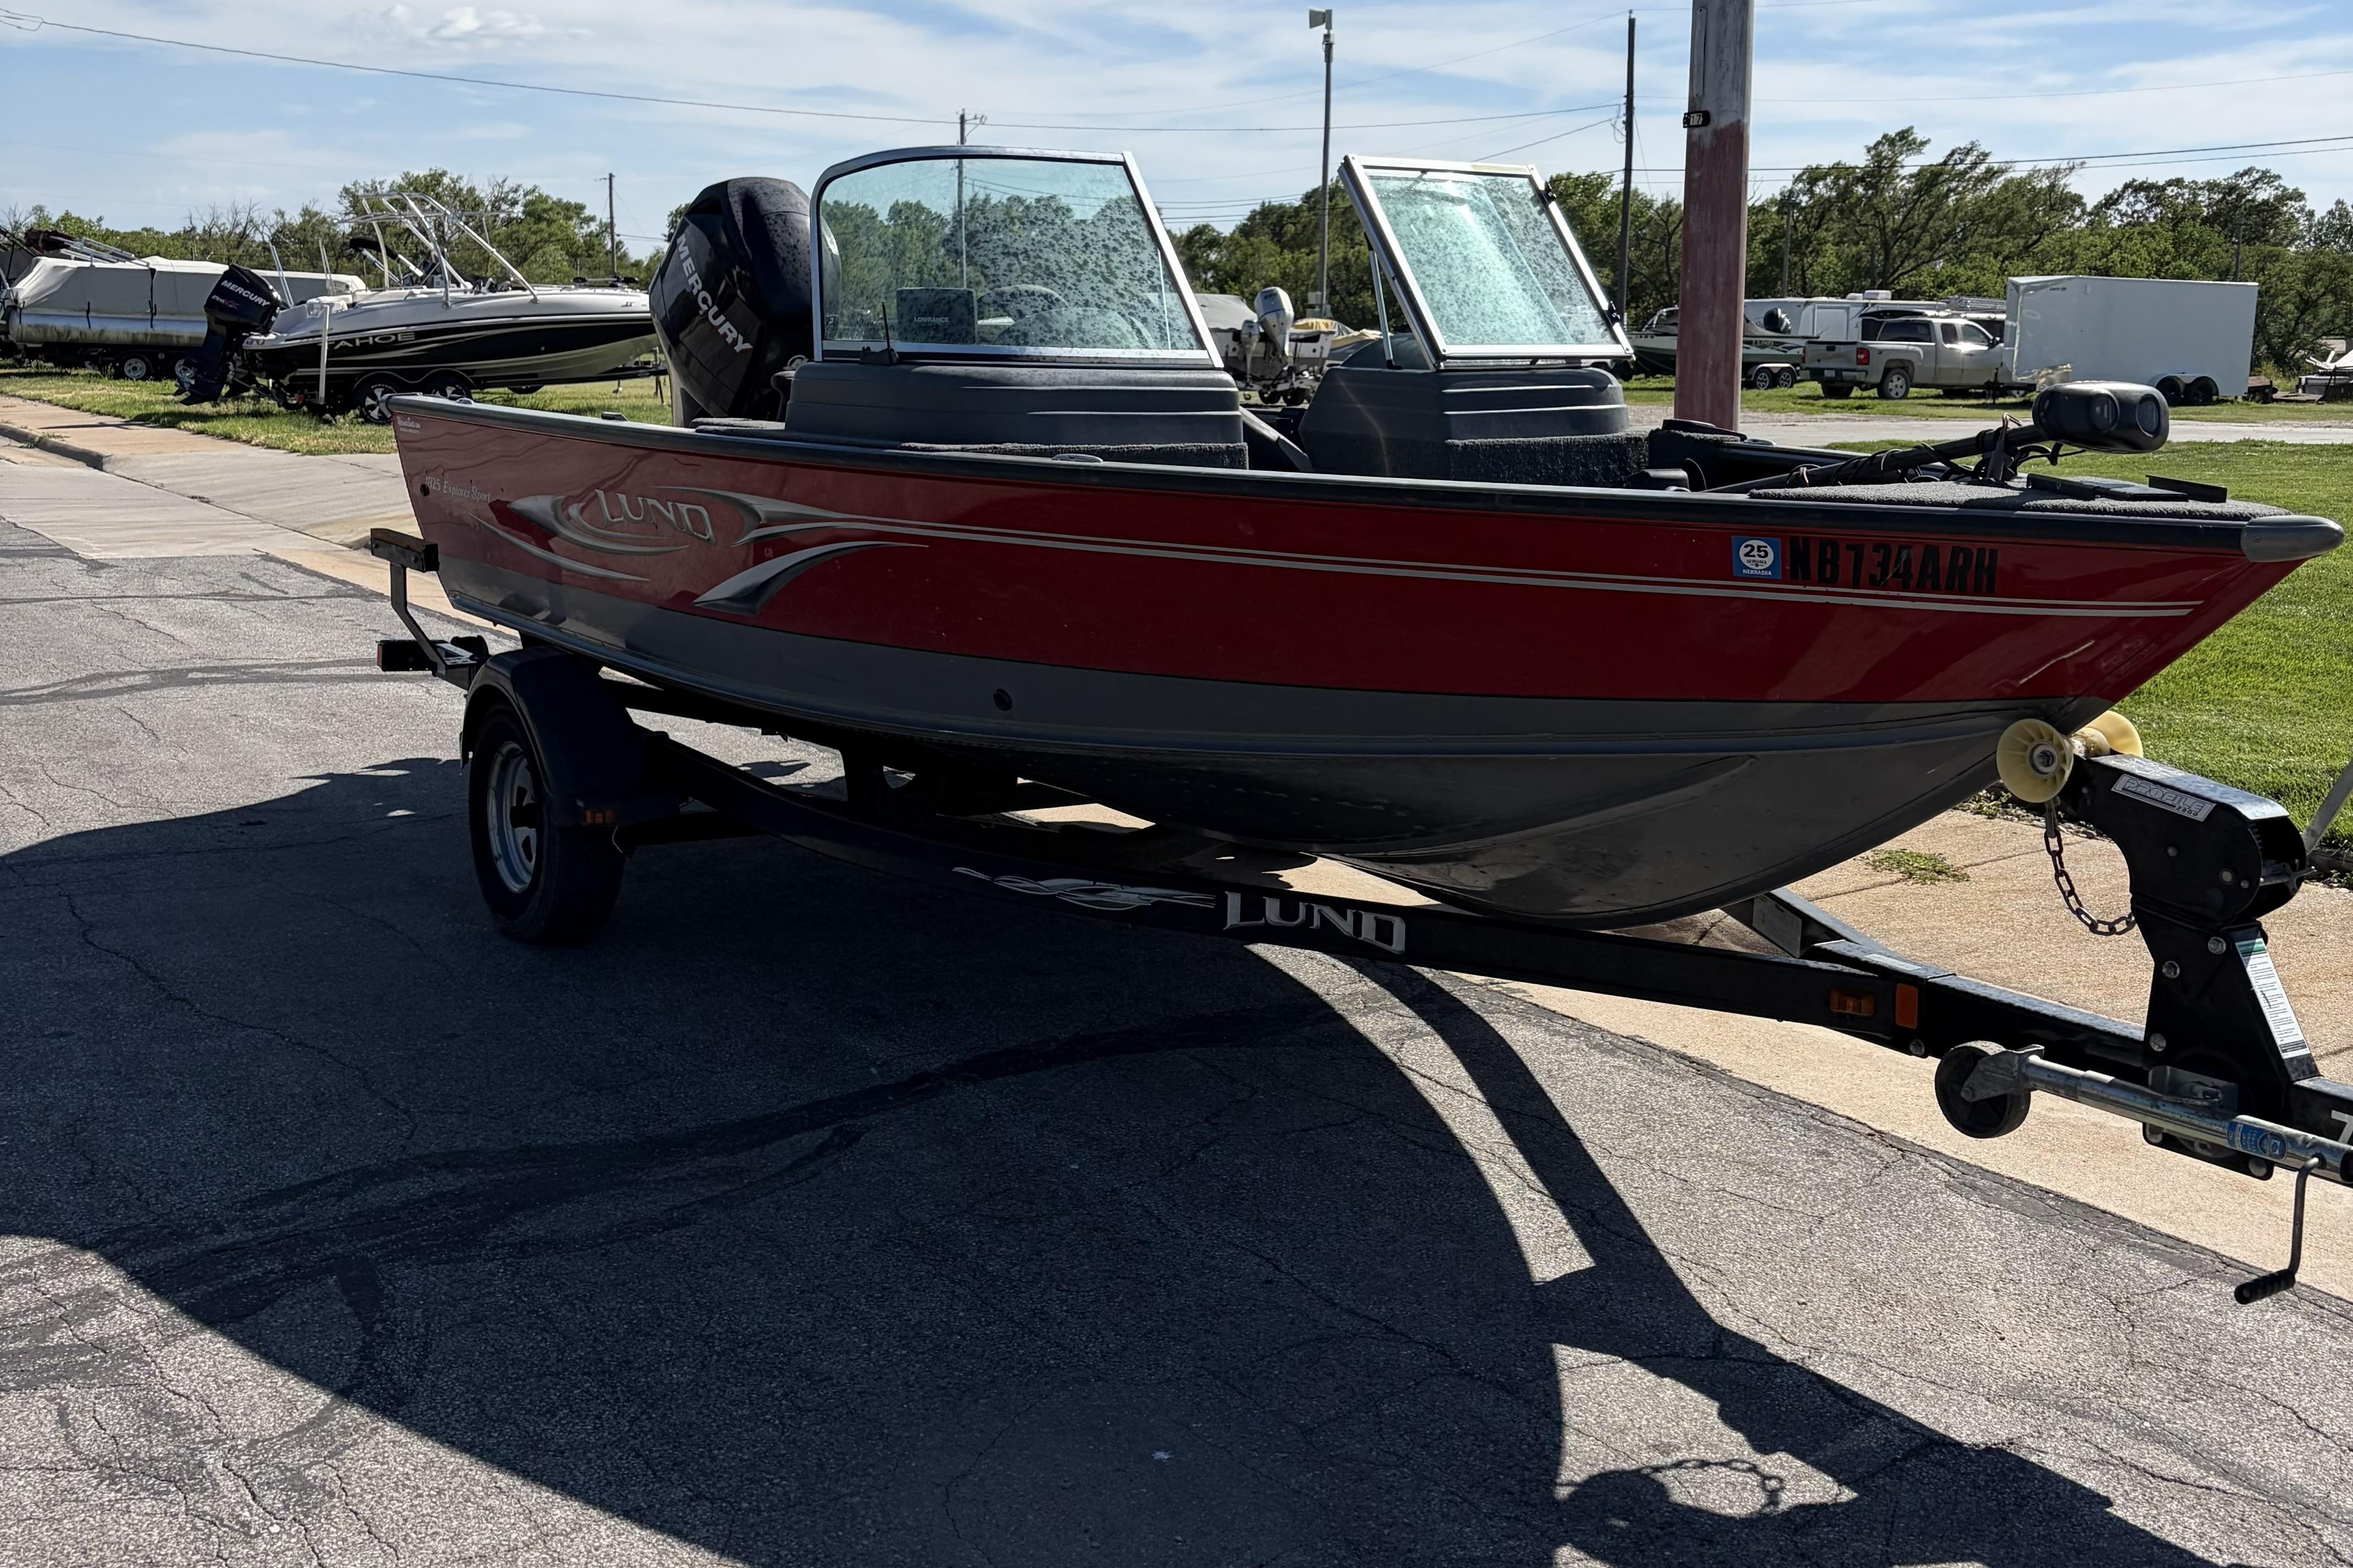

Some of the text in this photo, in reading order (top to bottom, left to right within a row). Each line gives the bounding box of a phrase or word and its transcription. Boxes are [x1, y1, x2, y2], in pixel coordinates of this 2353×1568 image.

[1692, 114, 1702, 124] 17
[221, 280, 270, 306] MERCURY
[676, 234, 753, 354] MERCURY
[472, 486, 491, 503] Sport
[594, 489, 716, 545] LUND
[1744, 544, 1768, 559] 25
[2123, 778, 2205, 813] PROFILE
[1223, 891, 1406, 955] LUND
